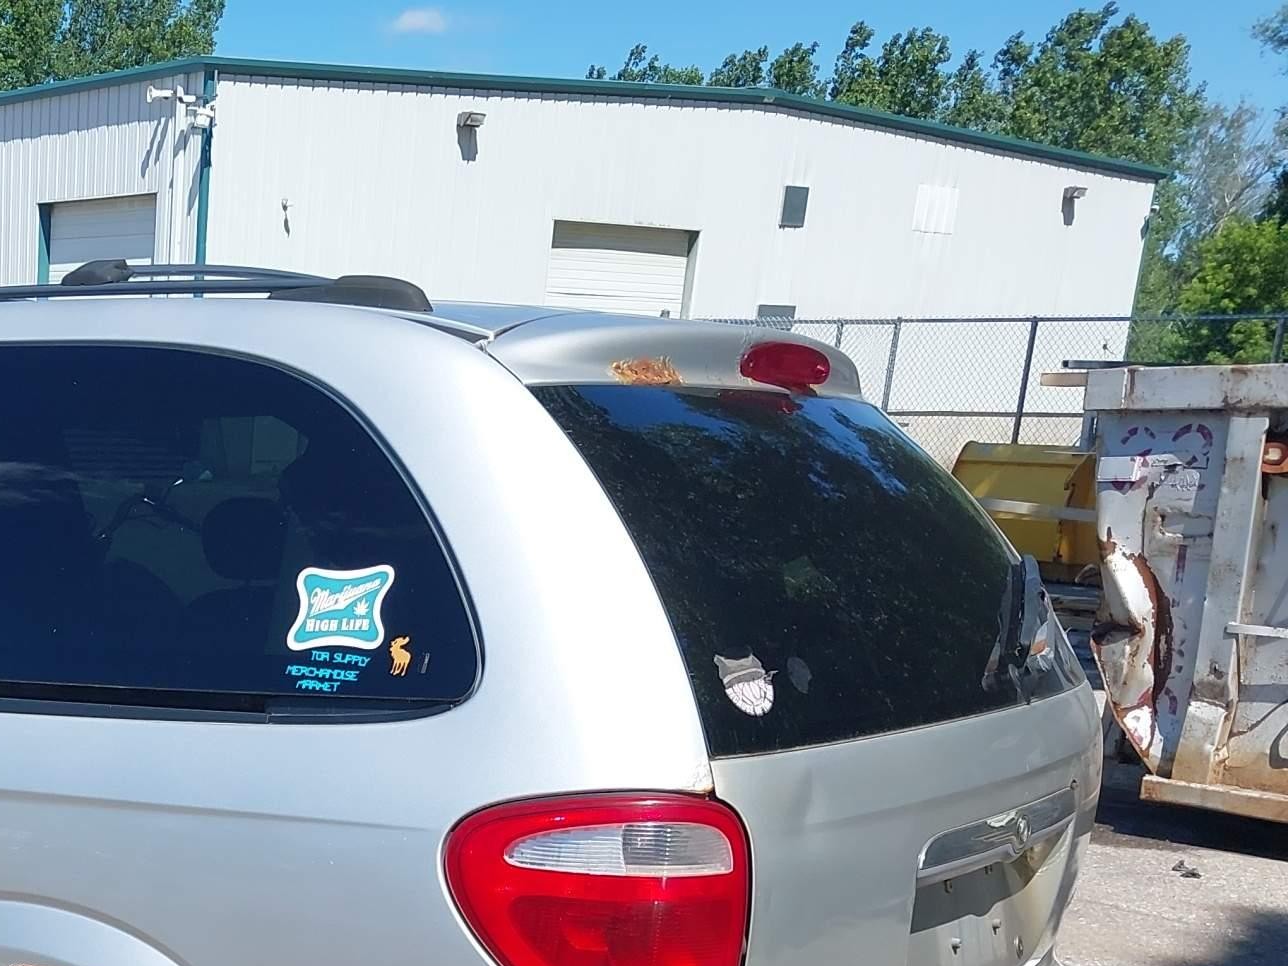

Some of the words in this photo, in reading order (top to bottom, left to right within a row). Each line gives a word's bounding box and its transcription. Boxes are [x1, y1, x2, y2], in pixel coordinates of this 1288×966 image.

[304, 618, 339, 632] HIGH
[341, 617, 370, 631] LIFE
[333, 653, 371, 666] SUPPLY
[285, 665, 360, 680] MERCHANDISE
[296, 680, 340, 692] MARKET
